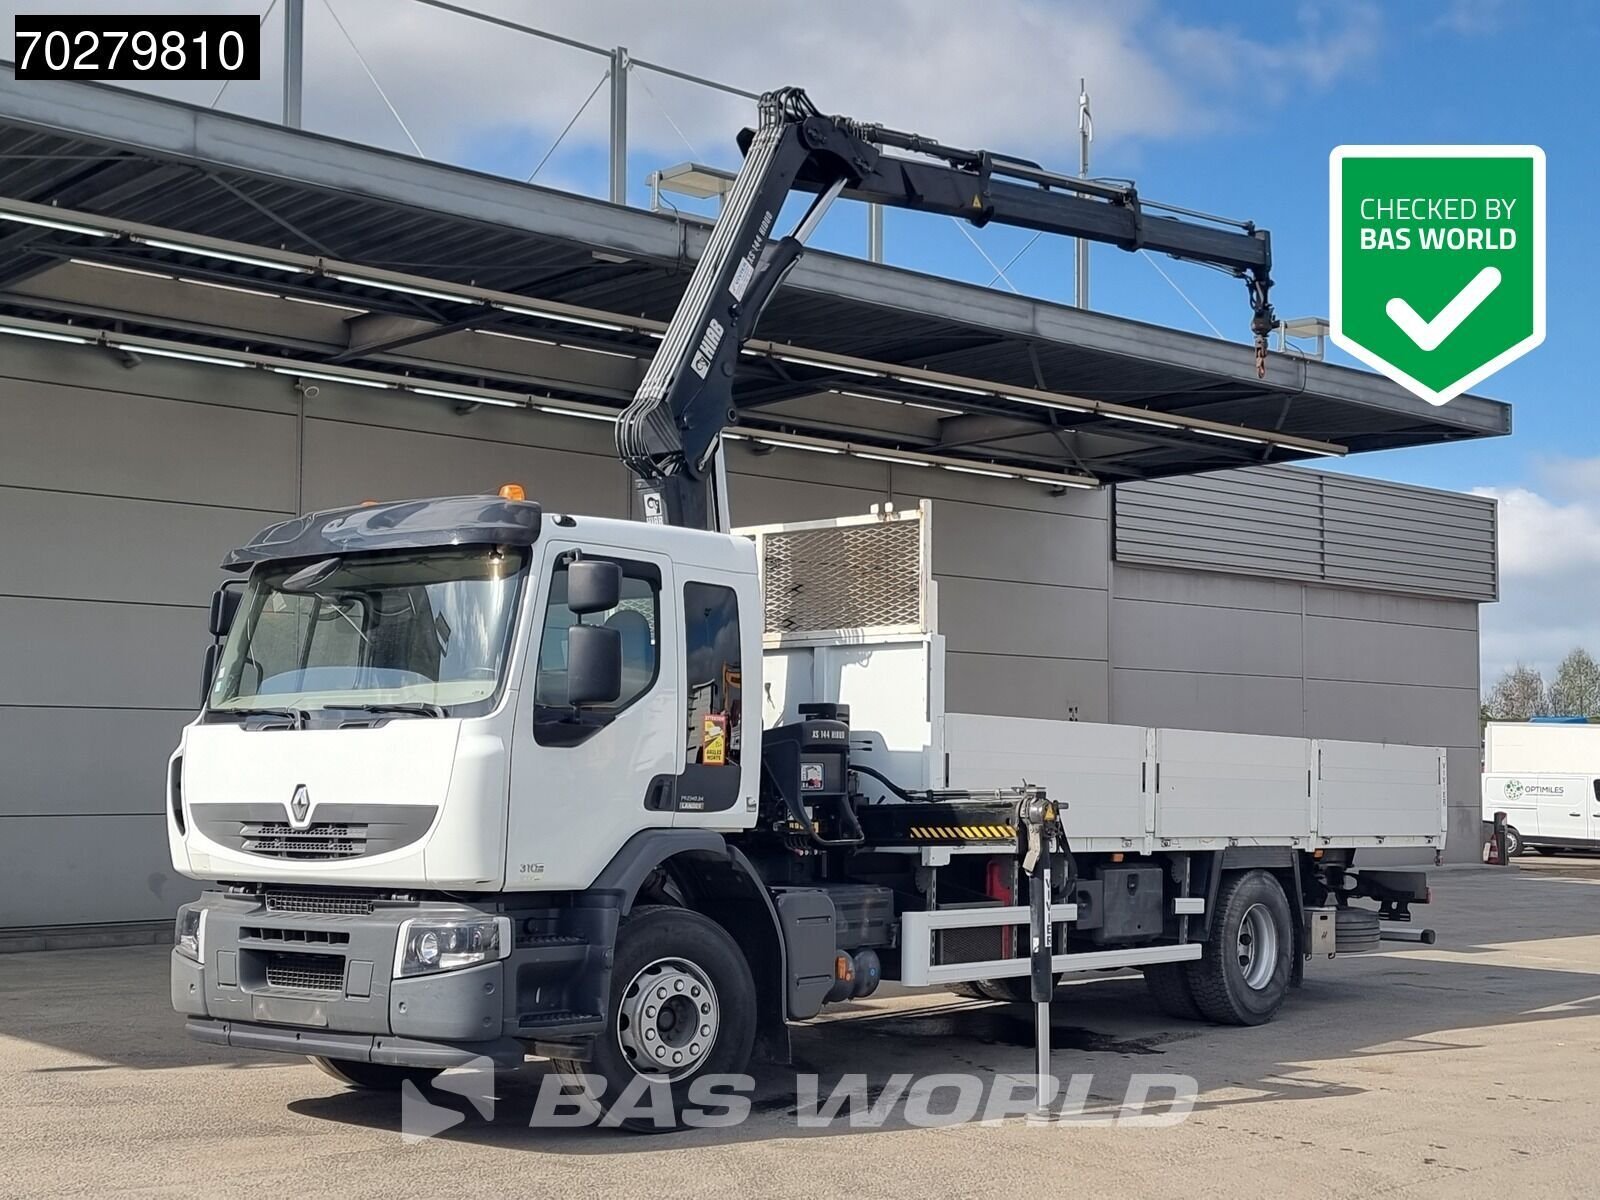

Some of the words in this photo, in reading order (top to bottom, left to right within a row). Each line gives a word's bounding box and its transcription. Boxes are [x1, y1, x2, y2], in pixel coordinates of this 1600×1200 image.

[699, 318, 724, 361] HIAB
[820, 730, 830, 739] 144
[1524, 785, 1565, 794] OPTIMILES
